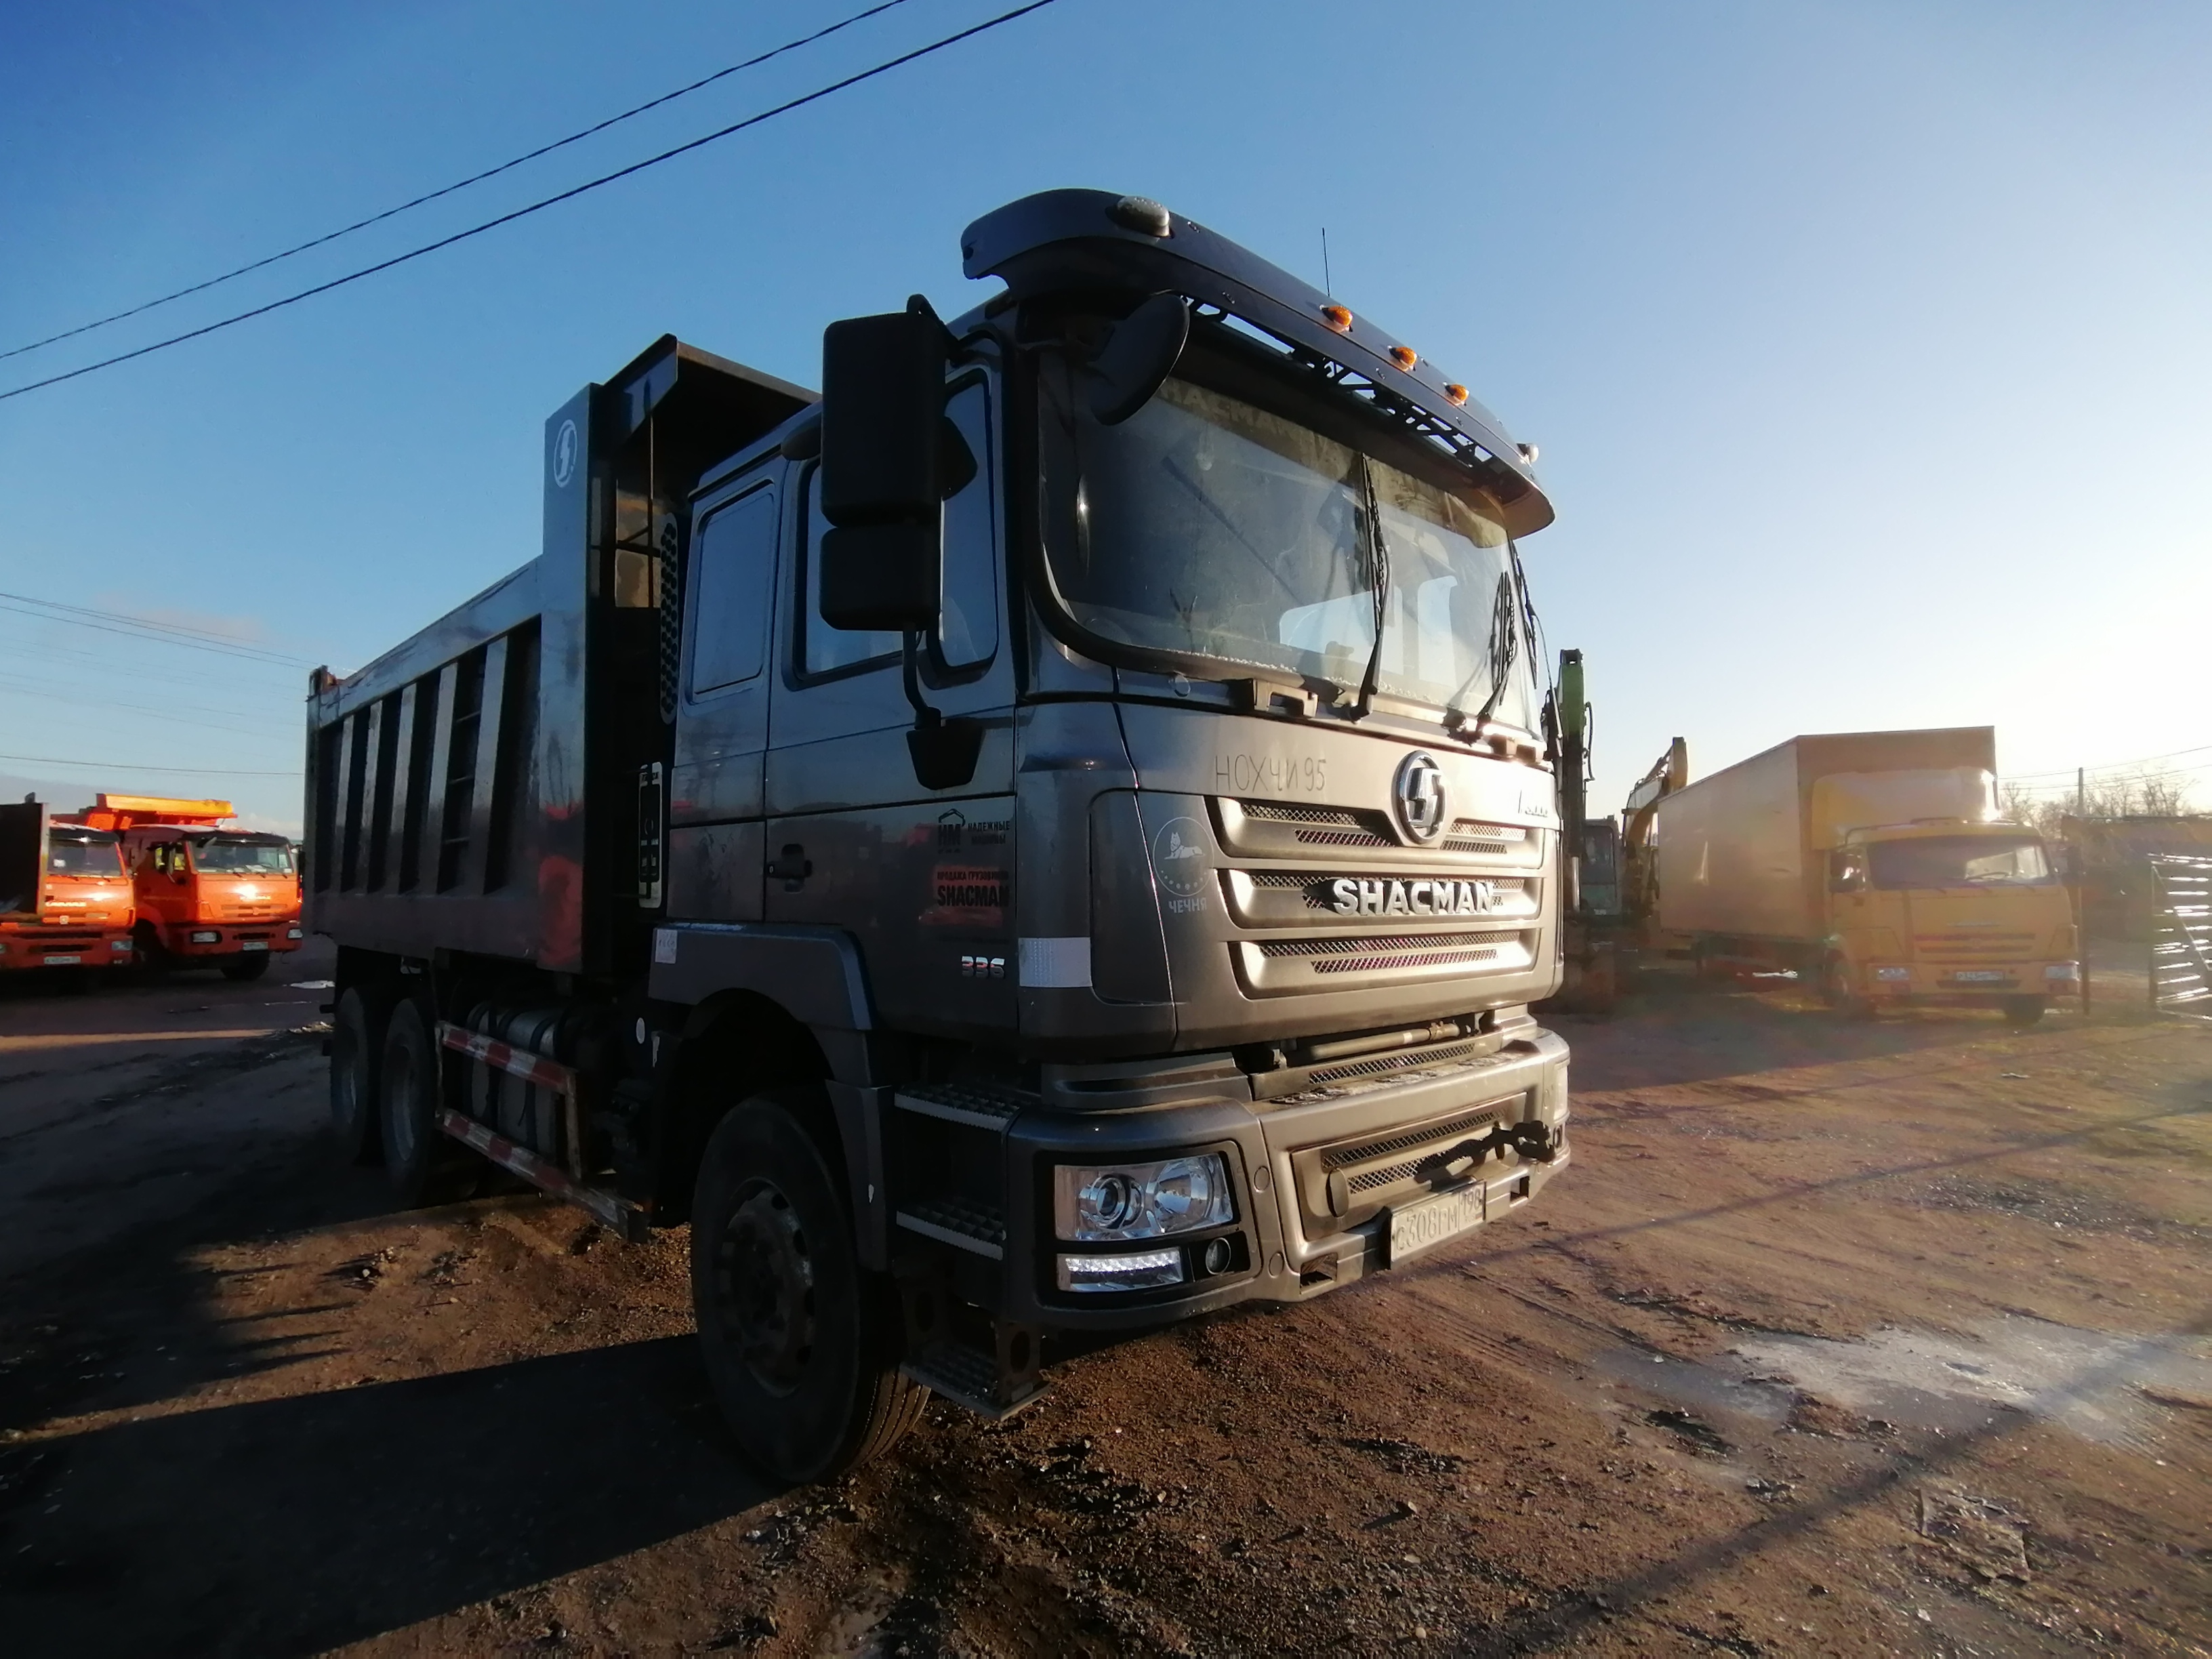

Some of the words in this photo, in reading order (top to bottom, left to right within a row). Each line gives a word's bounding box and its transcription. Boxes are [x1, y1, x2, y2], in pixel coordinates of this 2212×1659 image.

[1215, 754, 1298, 794] НОХЧИ
[1304, 756, 1327, 792] 95
[967, 820, 1010, 832] НАДЕЖНЫЕ
[937, 884, 1010, 907] SHACMAN
[1168, 897, 1208, 914] ЧЕЧНЯ
[1332, 878, 1494, 916] SHACMAN
[961, 955, 1006, 979] 336
